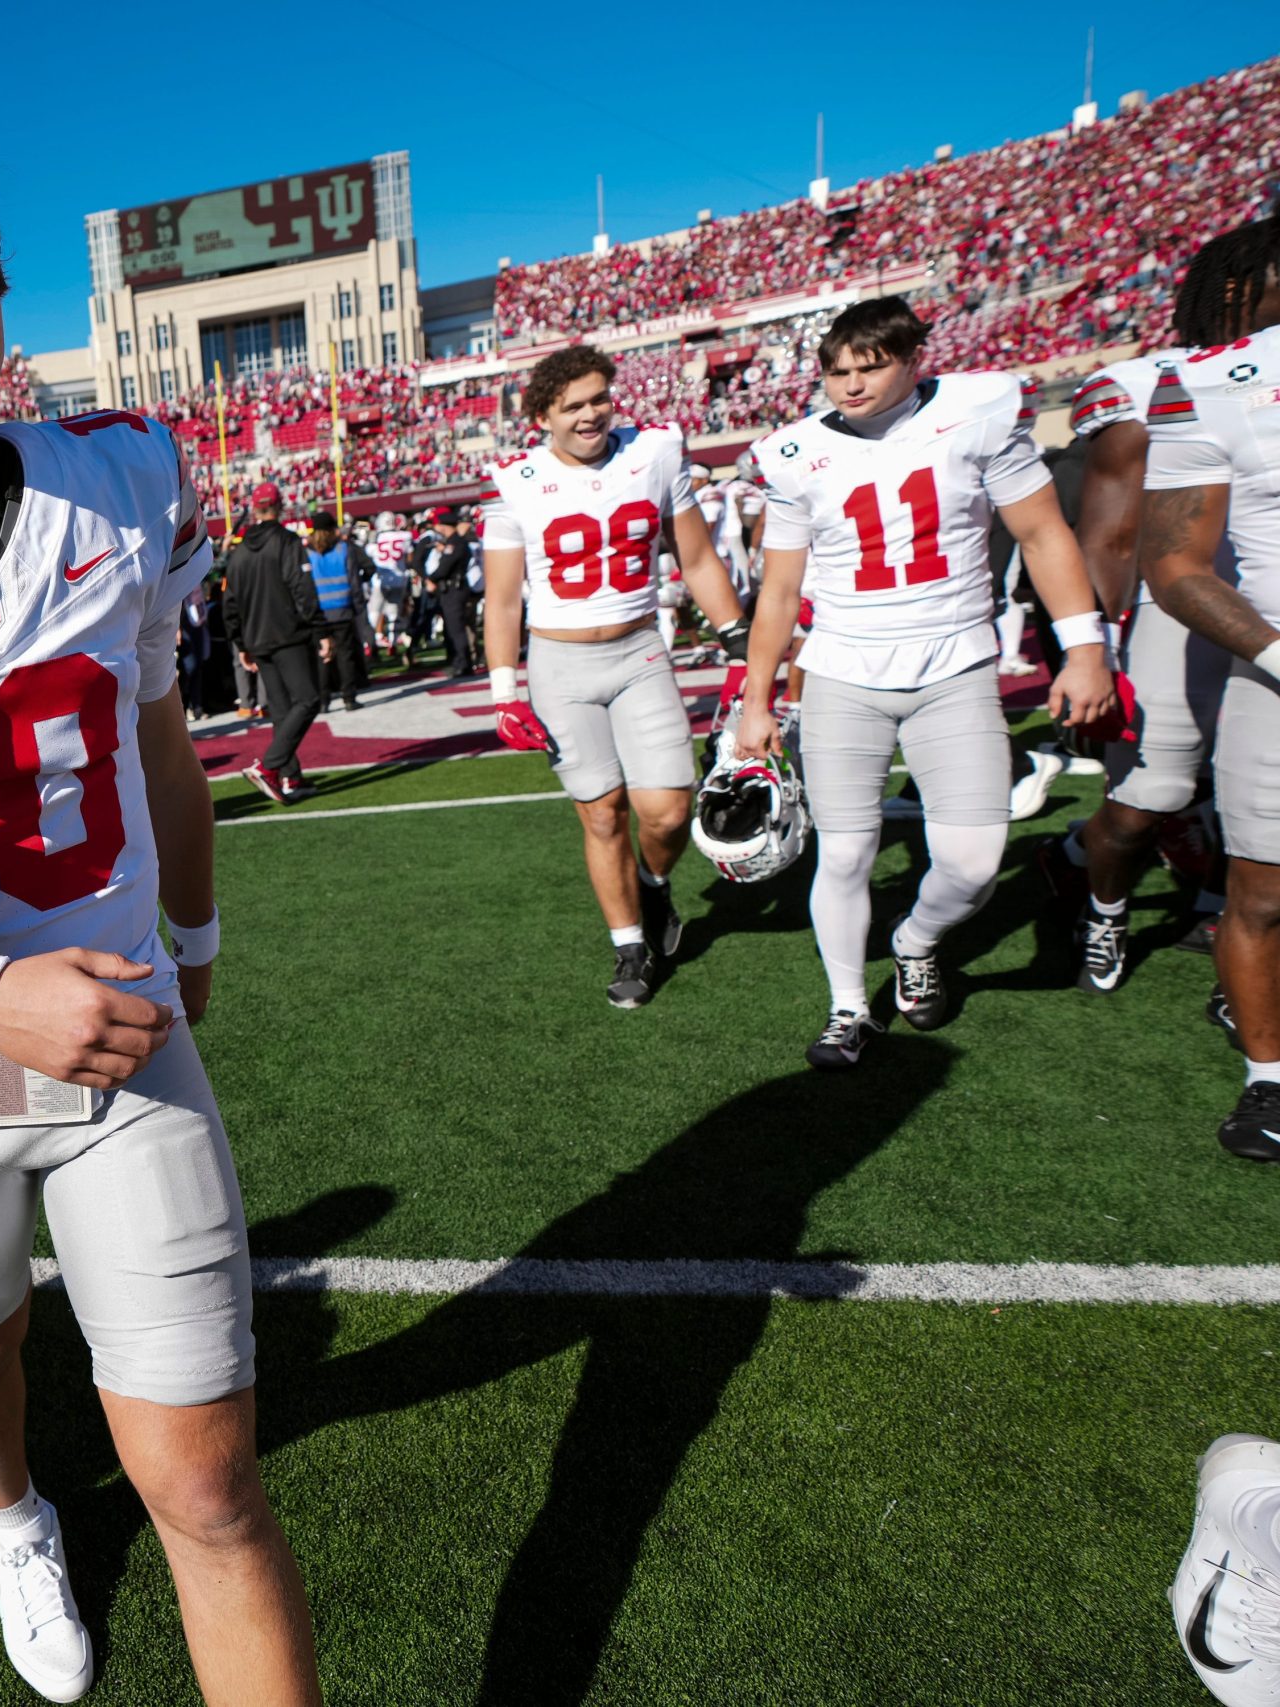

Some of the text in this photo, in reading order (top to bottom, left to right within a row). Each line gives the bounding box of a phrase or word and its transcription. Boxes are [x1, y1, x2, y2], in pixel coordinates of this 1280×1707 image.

[640, 308, 715, 334] FOOTBALL
[377, 539, 404, 561] 55
[543, 499, 659, 600] 88
[843, 466, 948, 591] 11
